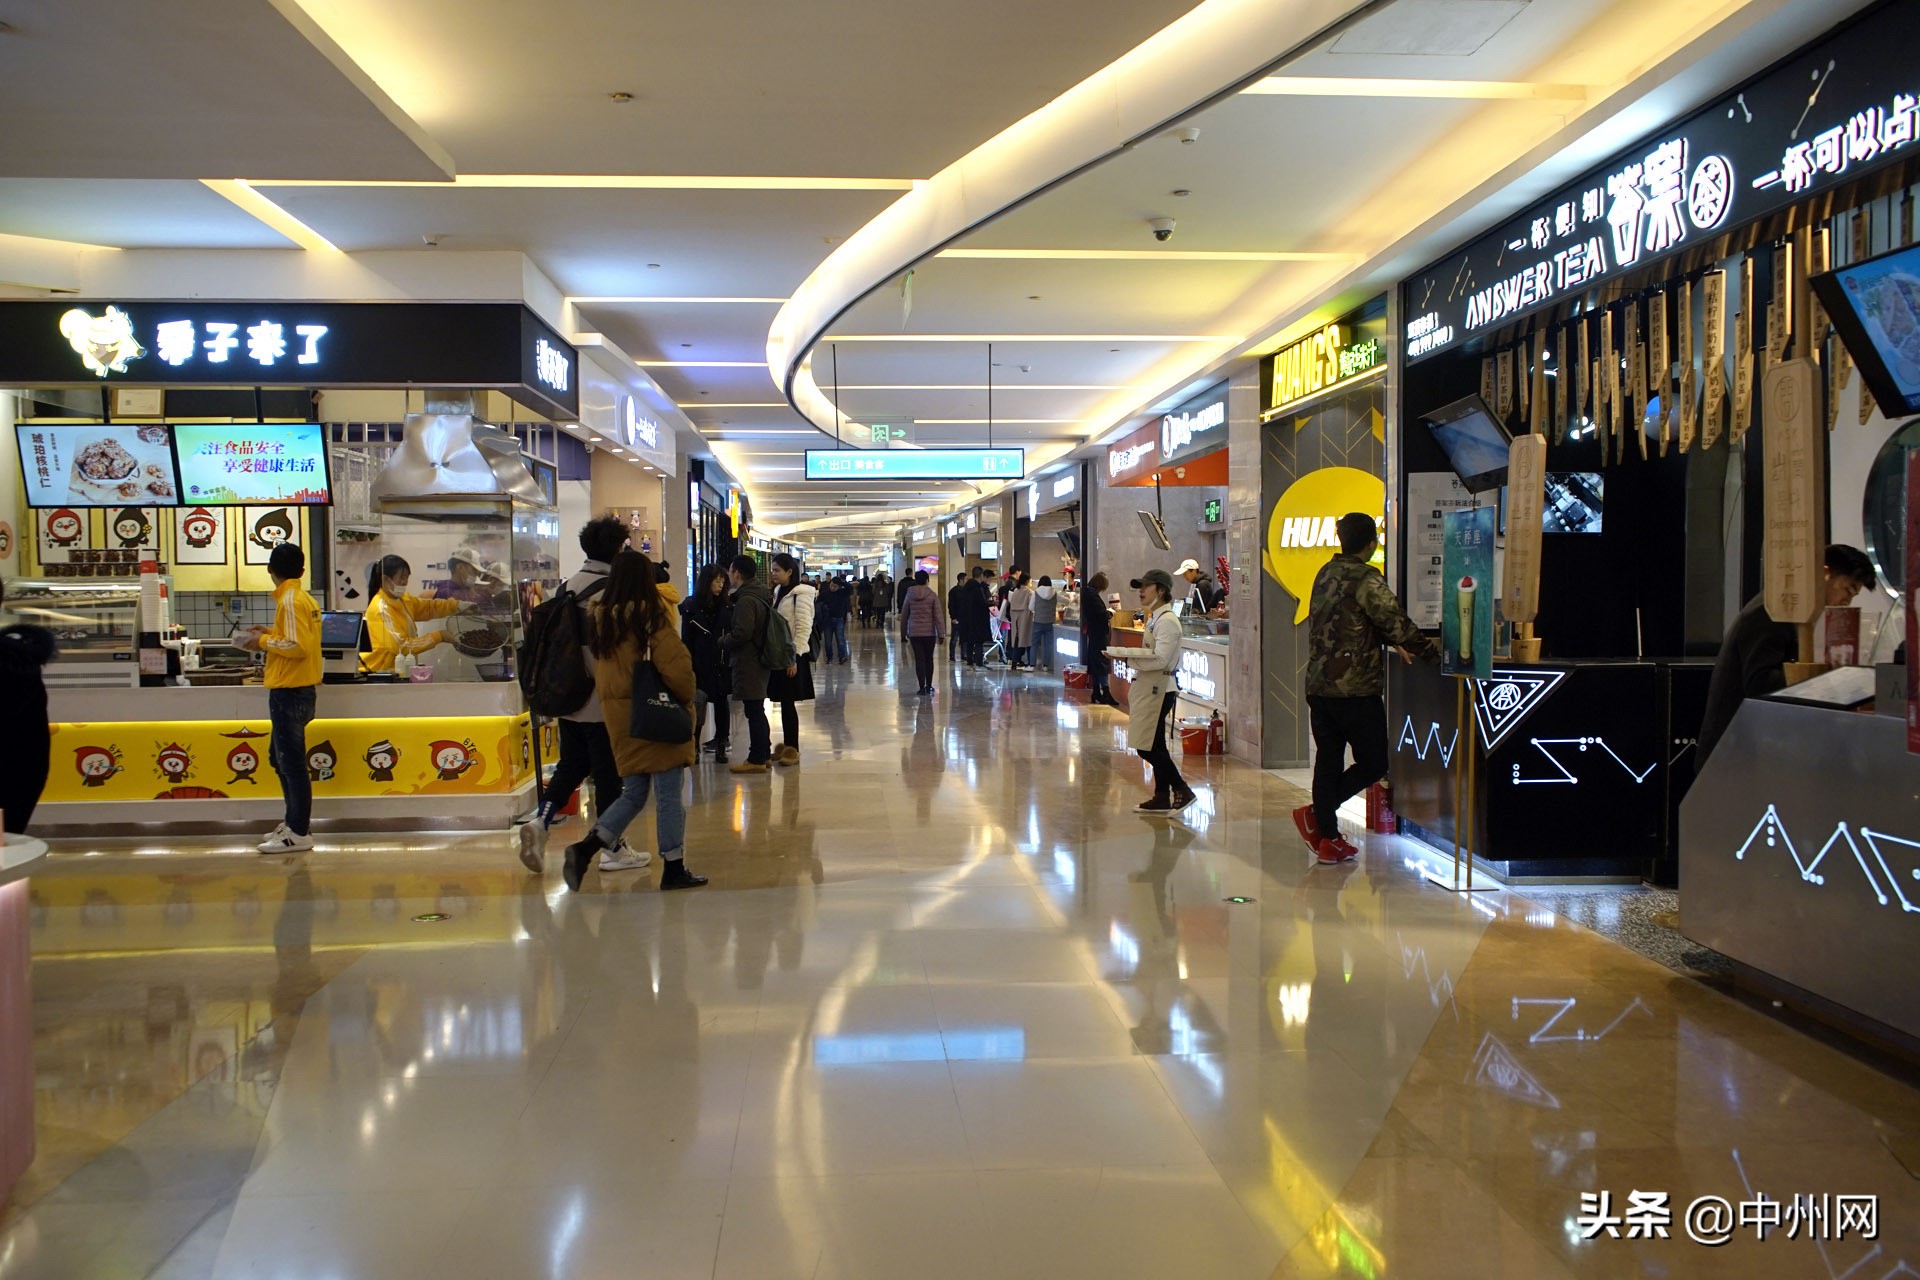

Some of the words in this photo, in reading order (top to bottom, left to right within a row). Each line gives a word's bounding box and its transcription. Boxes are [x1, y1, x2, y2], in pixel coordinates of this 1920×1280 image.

[1466, 261, 1553, 331] ANSWER
[1554, 236, 1607, 290] TEA
[1271, 324, 1340, 408] HUANG'S
[32, 433, 52, 488] 琥珀核桃仁
[223, 457, 316, 473] 享受健康生活
[829, 459, 851, 470] 出口
[108, 743, 124, 760] BYE
[462, 737, 478, 756] BYE
